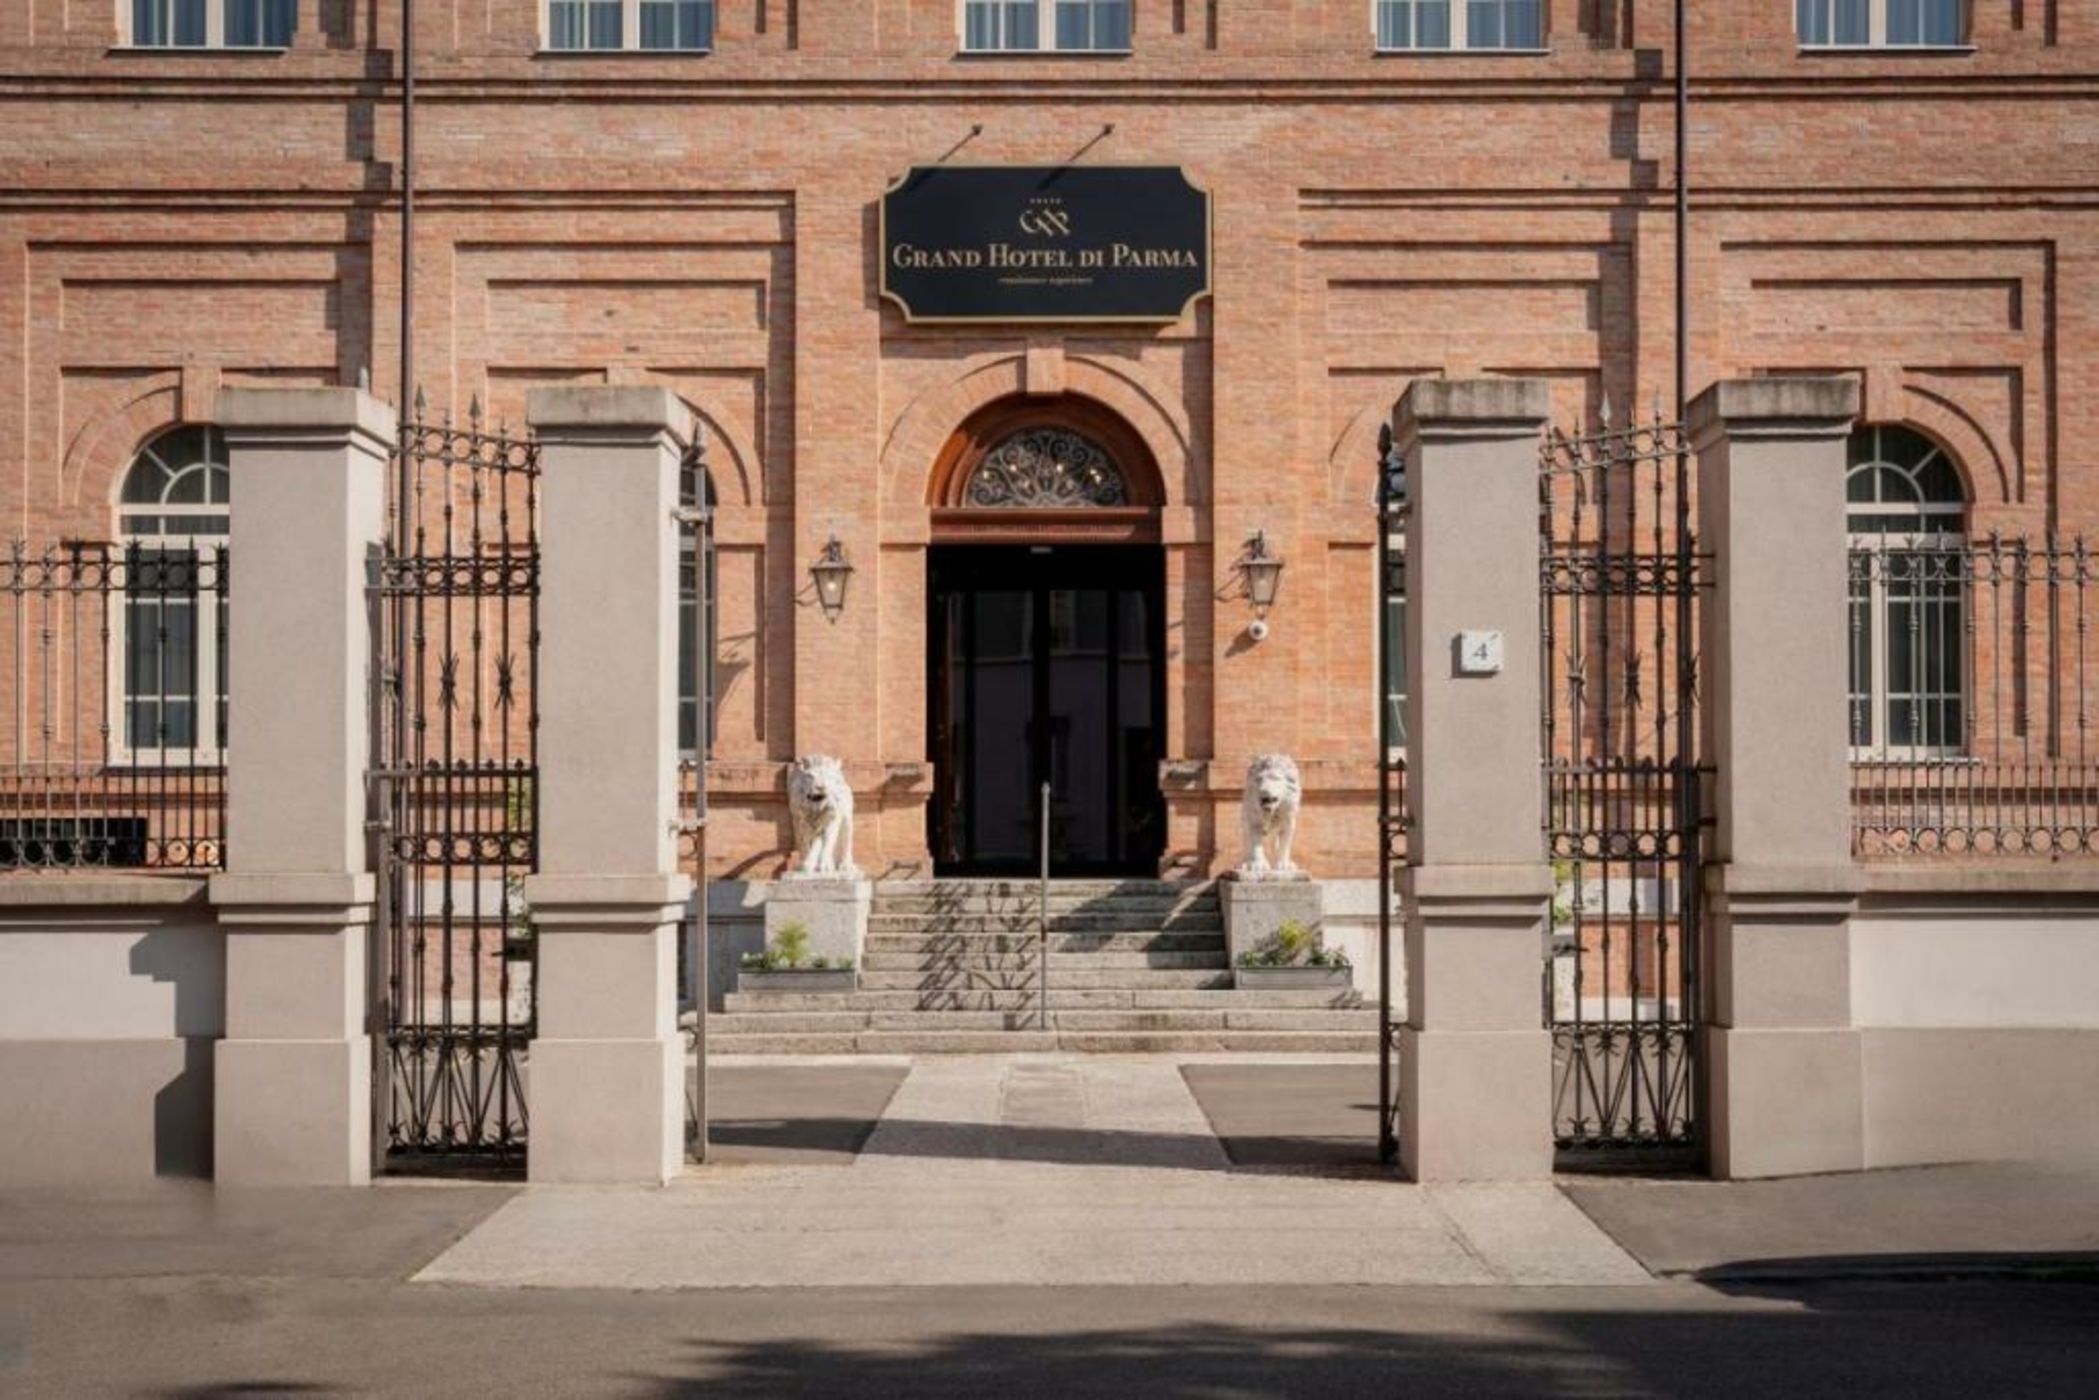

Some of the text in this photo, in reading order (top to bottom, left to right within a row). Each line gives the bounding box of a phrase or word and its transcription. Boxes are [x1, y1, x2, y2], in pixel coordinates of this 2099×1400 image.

[893, 243, 1198, 268] GRAND HOTEL DI PARMA
[1472, 643, 1489, 660] 4
